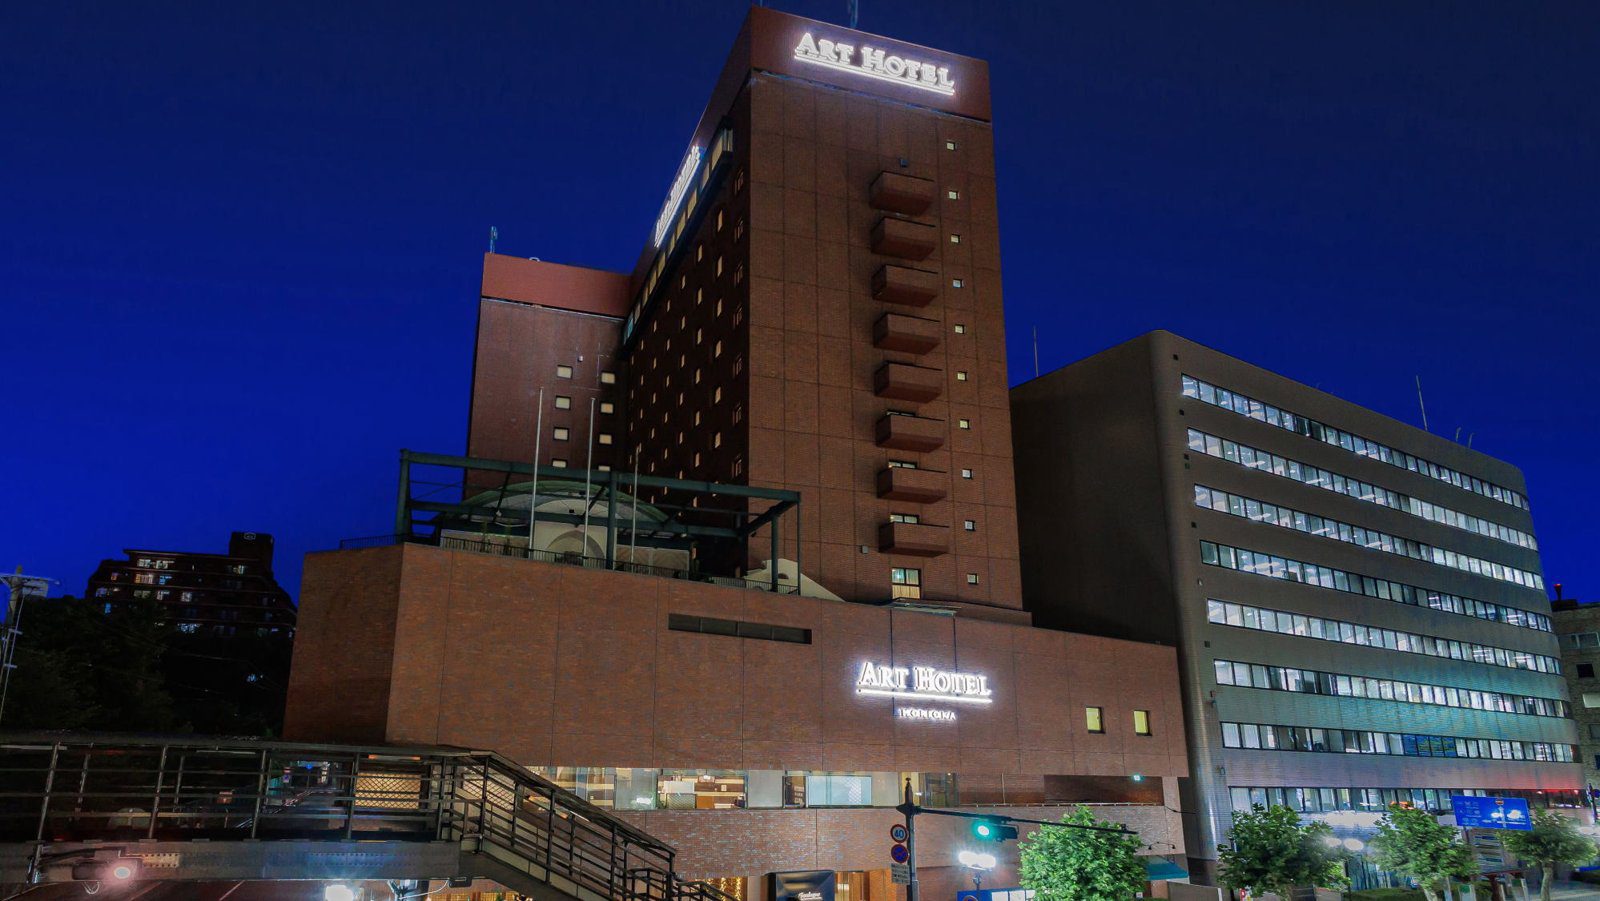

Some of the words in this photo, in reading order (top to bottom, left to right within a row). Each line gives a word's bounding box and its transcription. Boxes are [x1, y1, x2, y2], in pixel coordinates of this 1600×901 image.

[795, 33, 854, 63] ART
[861, 46, 954, 87] HOTEL
[857, 661, 910, 689] ART
[913, 667, 992, 696] HOTEL
[894, 830, 905, 839] 40
